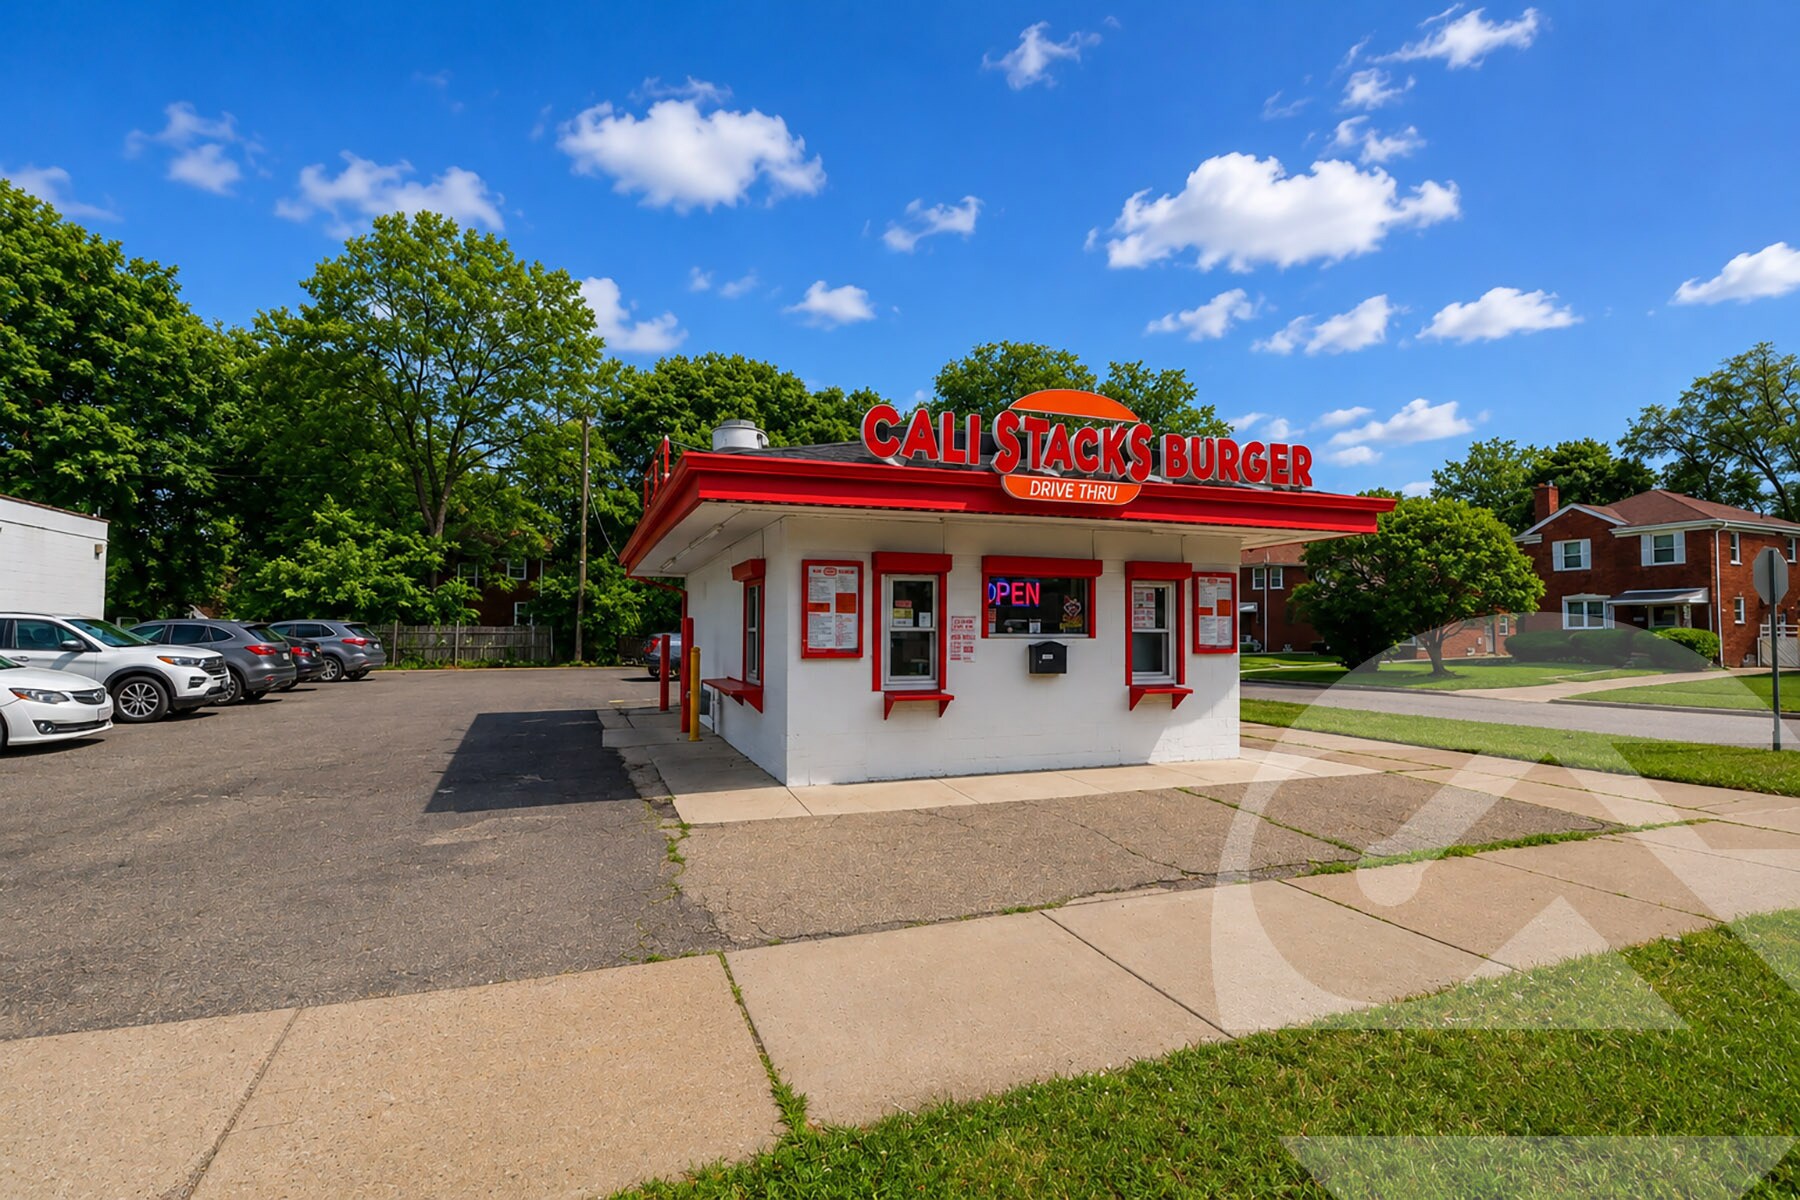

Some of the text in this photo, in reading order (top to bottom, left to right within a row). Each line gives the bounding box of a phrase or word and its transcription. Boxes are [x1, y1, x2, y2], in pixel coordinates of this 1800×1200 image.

[861, 404, 1313, 487] CALI STACKS BURGER
[1030, 480, 1118, 501] DRIVE THRU
